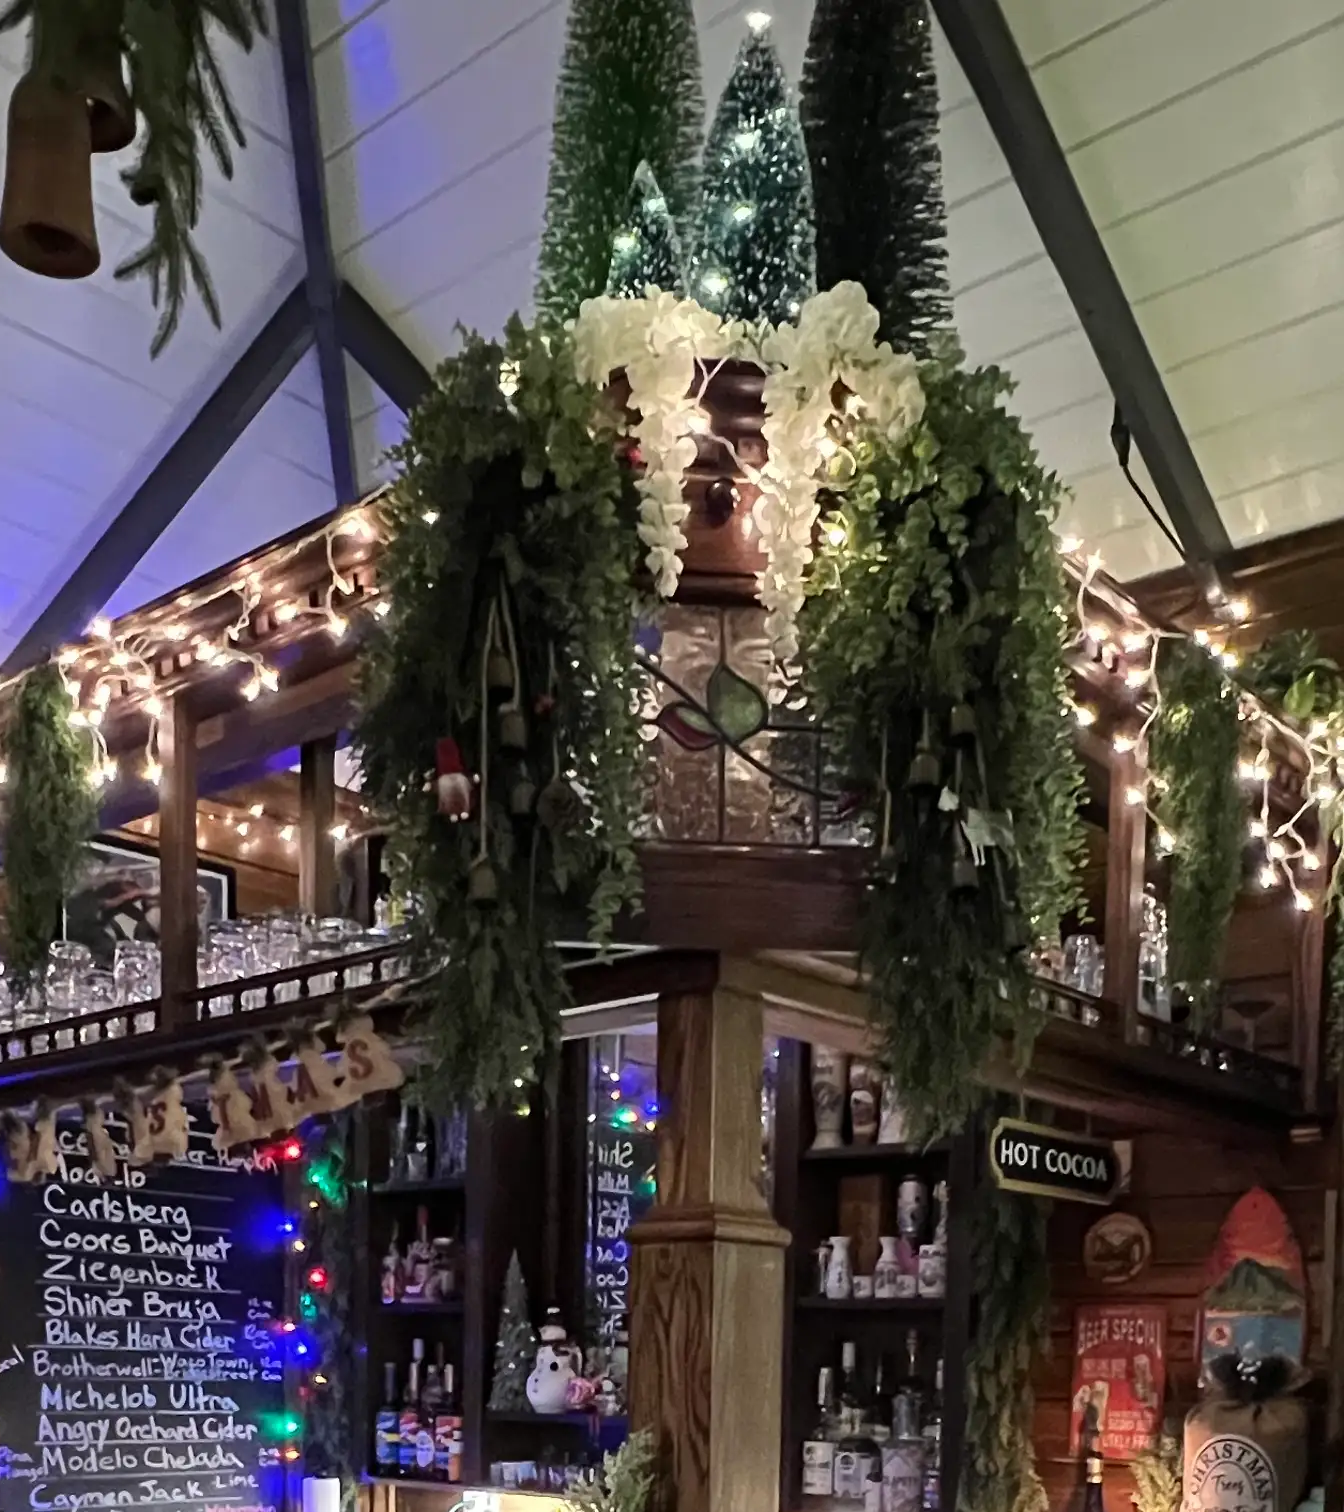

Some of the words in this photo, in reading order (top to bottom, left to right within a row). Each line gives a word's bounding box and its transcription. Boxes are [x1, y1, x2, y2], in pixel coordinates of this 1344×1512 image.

[1000, 1138, 1041, 1170] HOT
[1045, 1148, 1108, 1182] COCOA
[43, 1184, 192, 1242] Carlsberg
[40, 1219, 131, 1255] Coors
[138, 1228, 232, 1270] Banquet
[43, 1285, 133, 1317] Shiner
[142, 1291, 222, 1329] Bruja
[44, 1321, 120, 1350] Blakes
[126, 1321, 175, 1349] Hard
[180, 1324, 236, 1351] Cider
[40, 1383, 156, 1412] Michelob
[169, 1383, 241, 1413] Ultra
[38, 1414, 110, 1453] Angry
[114, 1415, 199, 1442] Orchard
[201, 1416, 258, 1442] Cider
[41, 1446, 138, 1475] Modelo
[143, 1444, 245, 1470] Chelada
[1190, 1442, 1273, 1501] CHRISTMAS
[138, 1480, 204, 1503] Jack
[1211, 1474, 1245, 1496] Trees
